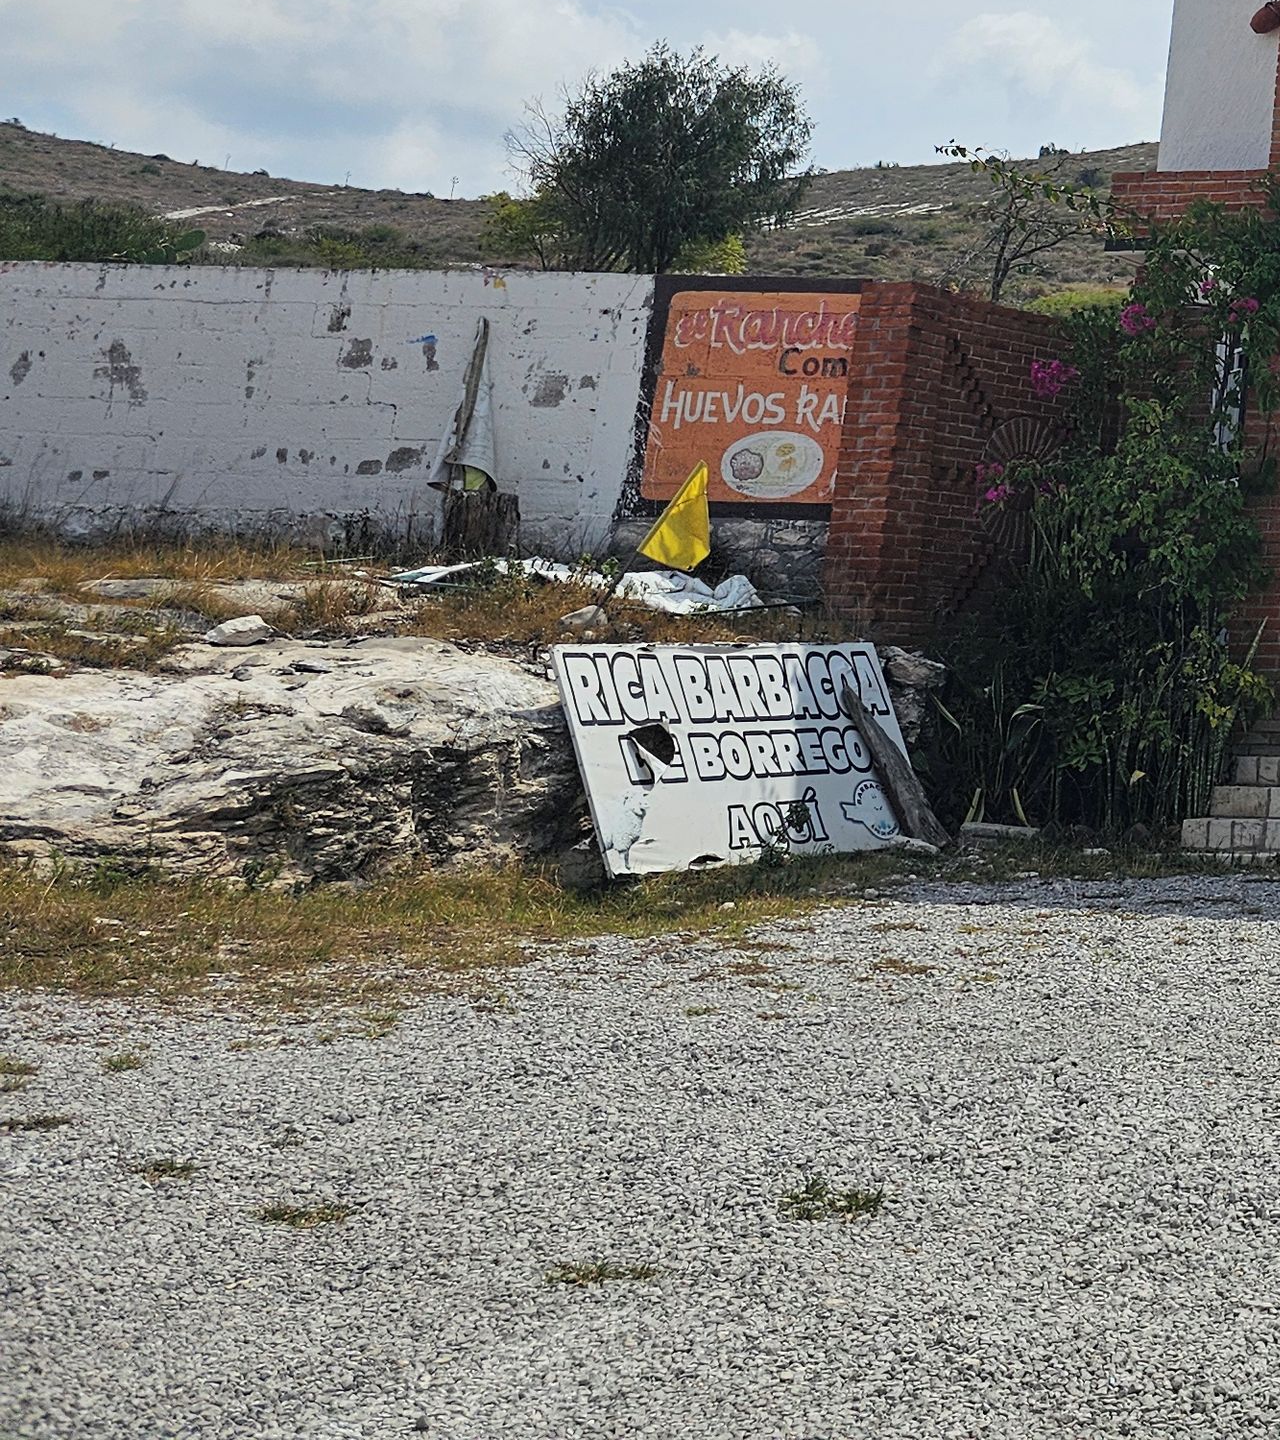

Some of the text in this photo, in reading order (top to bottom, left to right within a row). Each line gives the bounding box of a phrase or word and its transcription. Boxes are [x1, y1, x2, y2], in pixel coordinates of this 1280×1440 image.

[660, 379, 848, 433] HUEVOS RA
[563, 650, 891, 726] RICA BARBACOA
[689, 726, 874, 782] BORREGO
